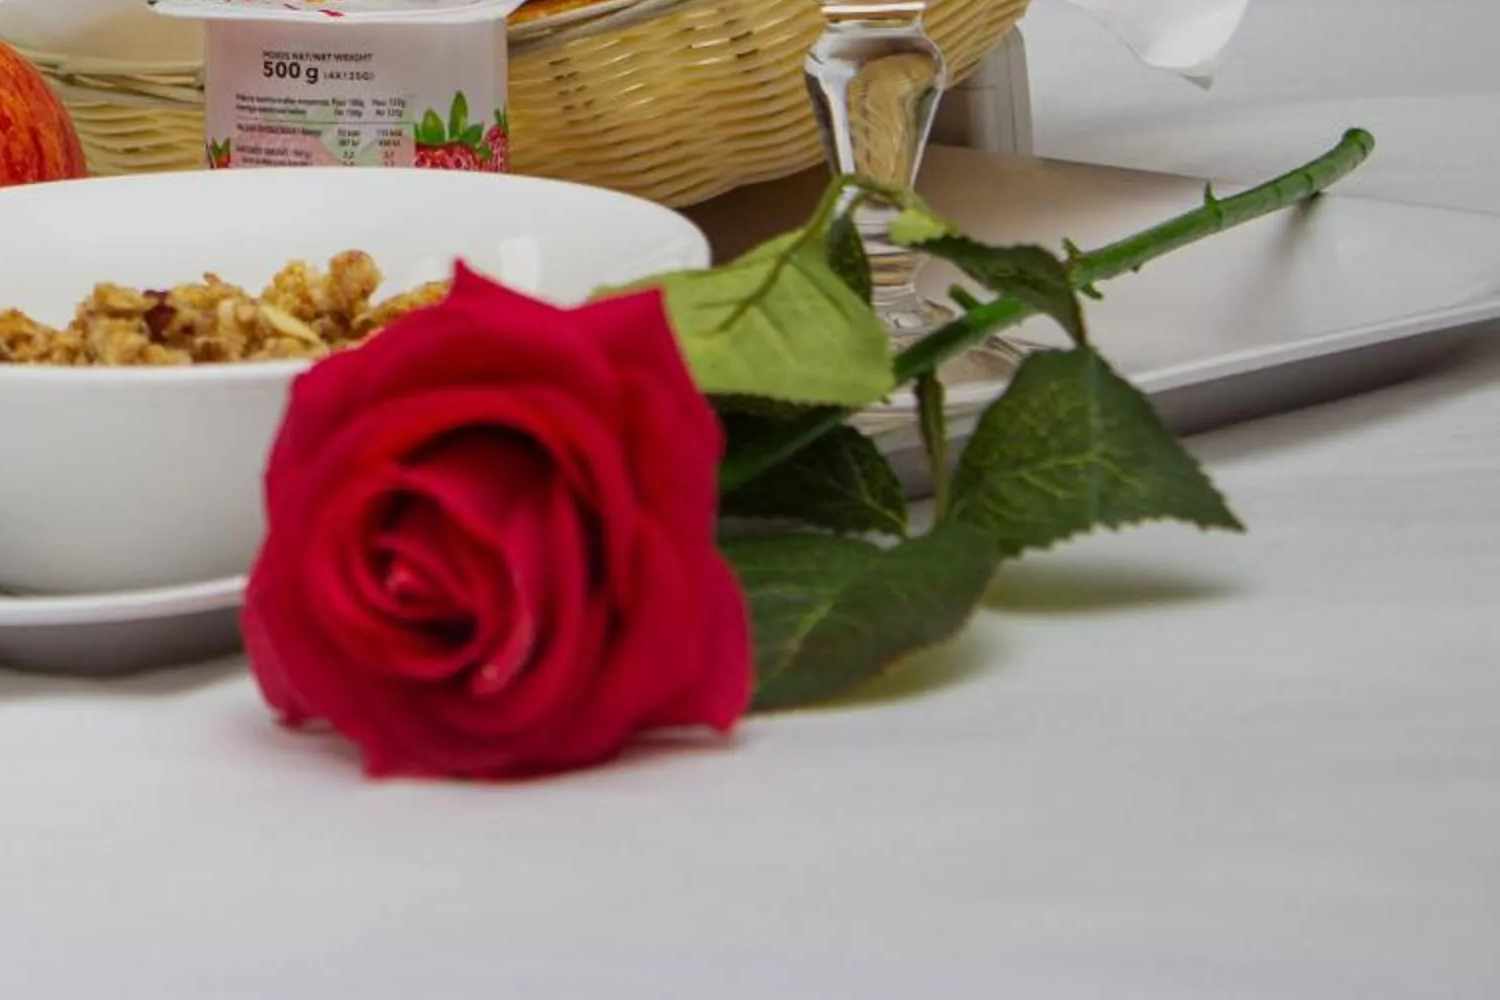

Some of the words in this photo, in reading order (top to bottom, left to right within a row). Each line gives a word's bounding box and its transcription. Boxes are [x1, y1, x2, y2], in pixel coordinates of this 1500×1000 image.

[334, 52, 373, 62] WEIGHT
[263, 60, 301, 79] 500
[305, 67, 319, 85] g
